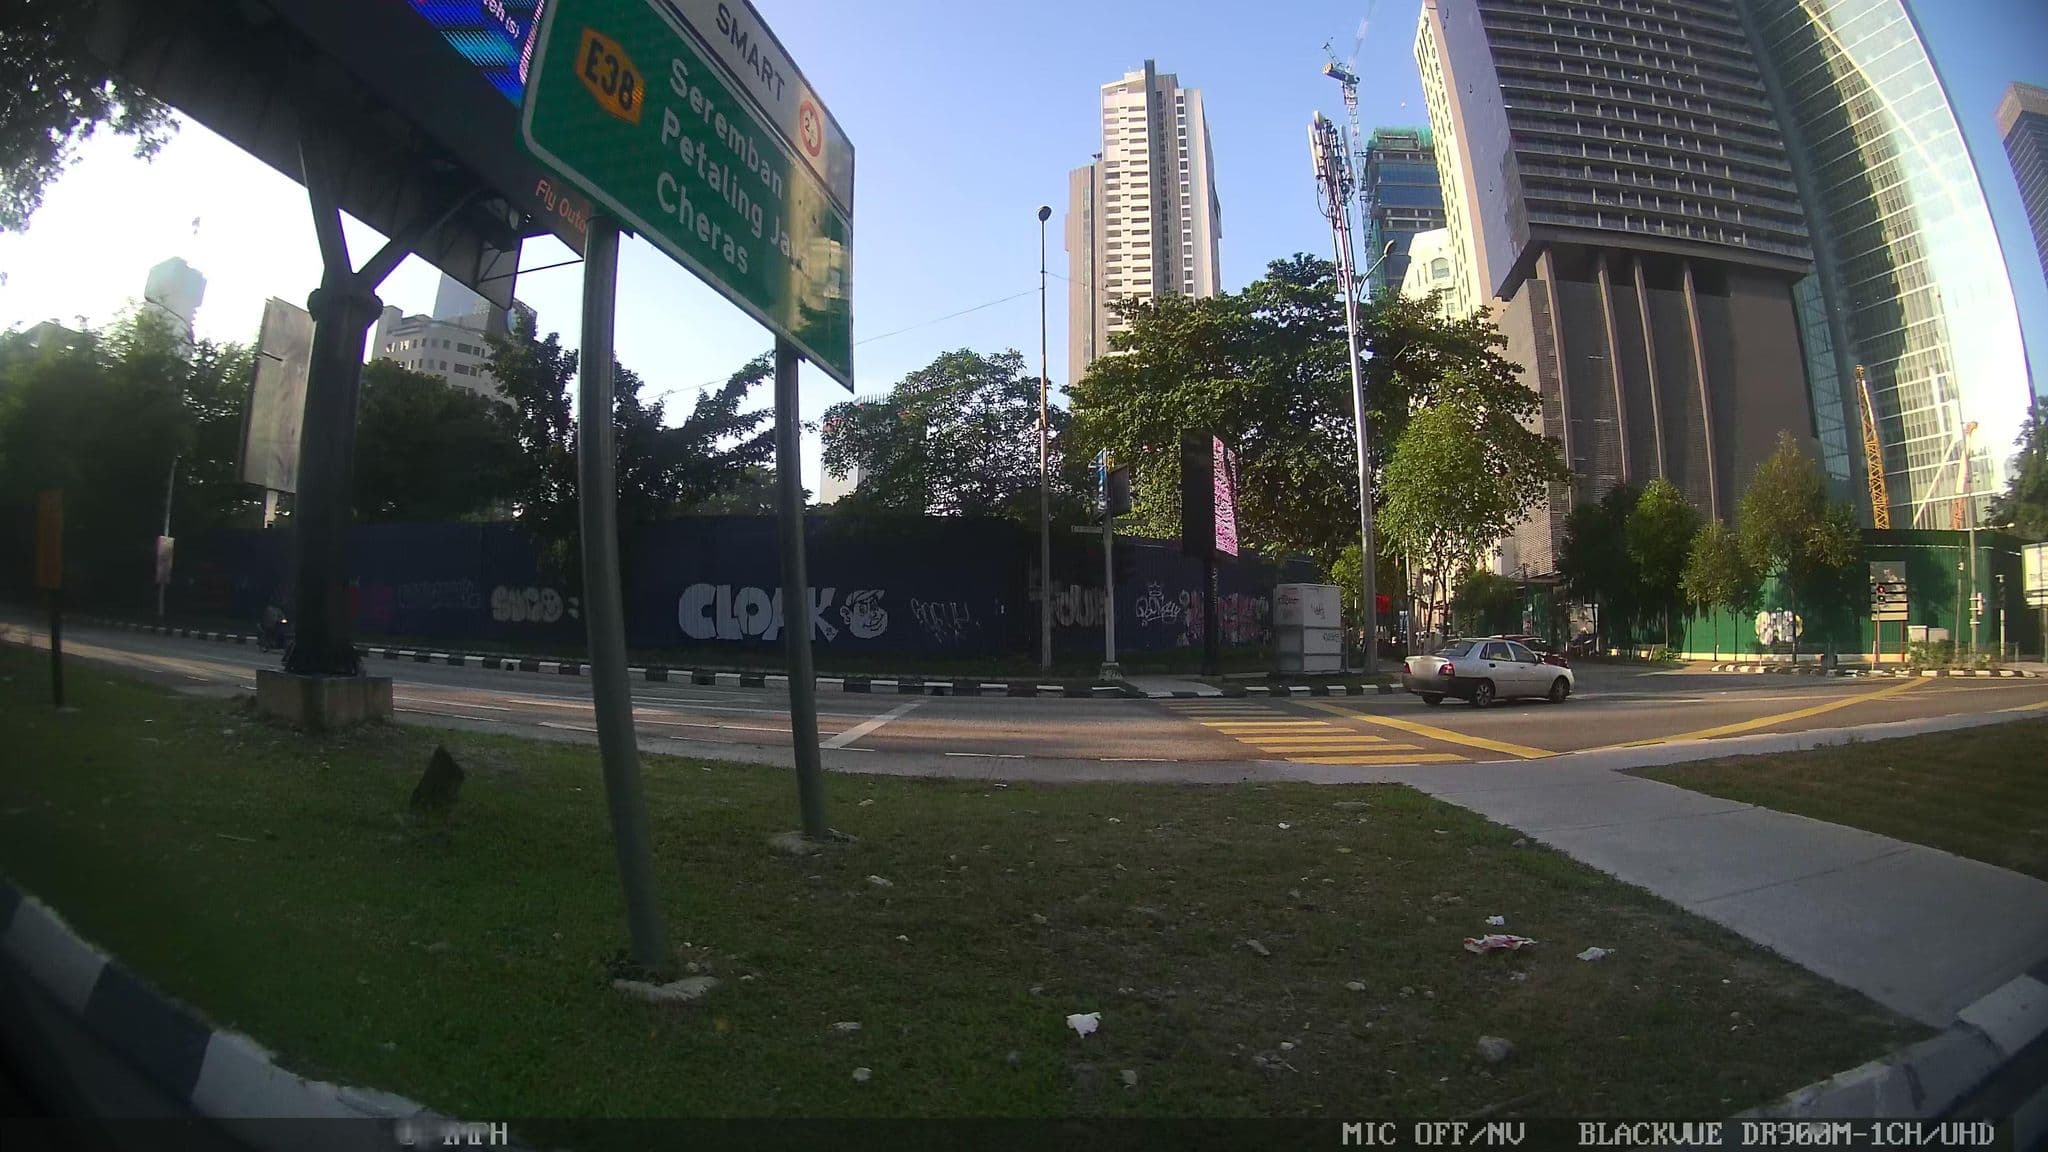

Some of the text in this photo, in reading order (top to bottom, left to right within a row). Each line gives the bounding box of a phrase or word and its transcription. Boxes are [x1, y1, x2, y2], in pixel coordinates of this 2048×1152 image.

[585, 38, 634, 110] E38
[716, 3, 785, 101] SMART
[661, 107, 763, 239] Petaling
[671, 58, 783, 200] Seremban
[536, 179, 556, 211] Fly
[657, 172, 748, 274] Cheras
